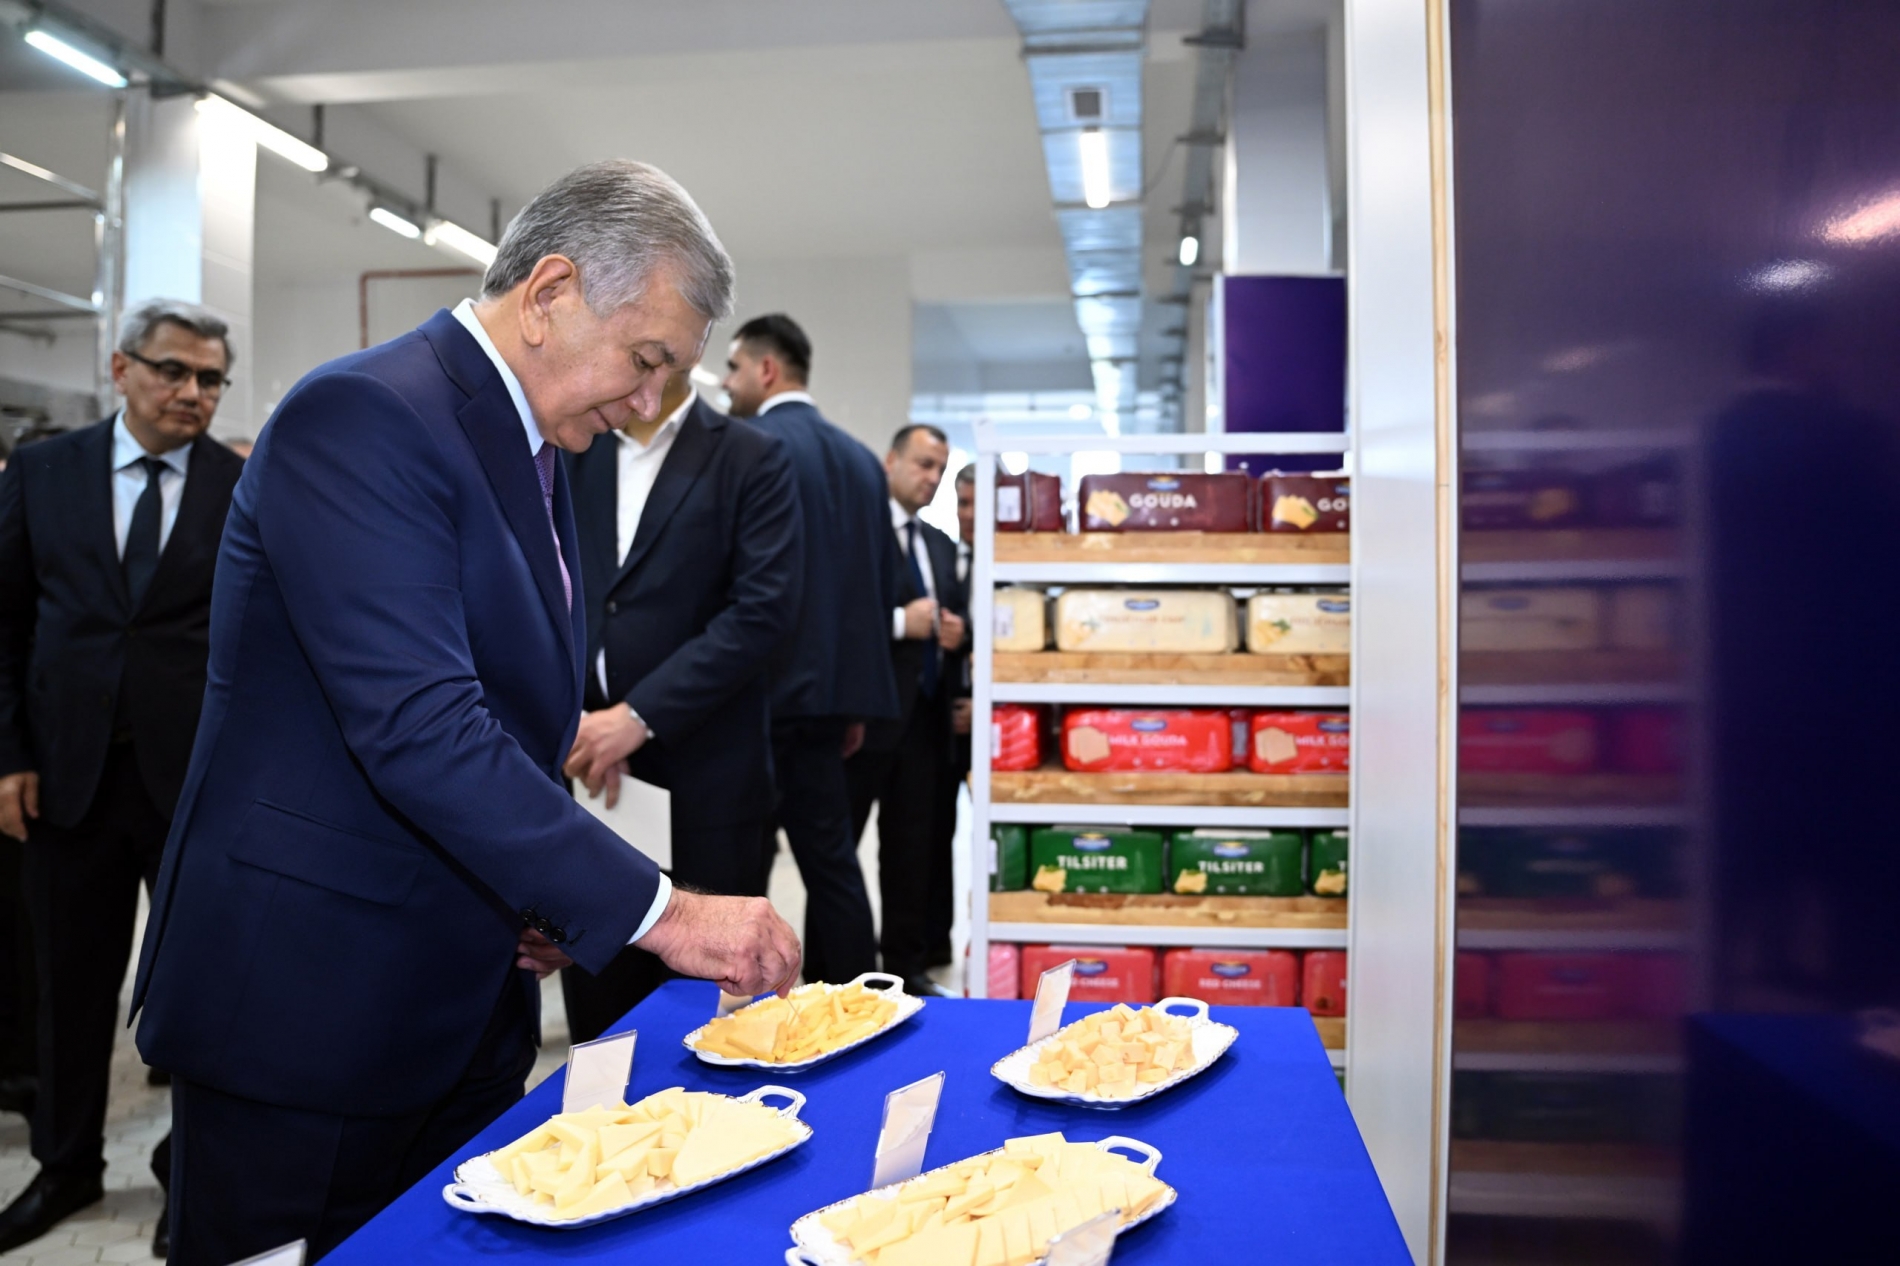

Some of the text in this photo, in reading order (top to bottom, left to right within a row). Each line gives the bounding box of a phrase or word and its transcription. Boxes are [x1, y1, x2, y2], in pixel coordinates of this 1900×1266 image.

[1128, 492, 1198, 509] GOUDA
[1141, 734, 1188, 747] GOUDA
[1056, 855, 1129, 870] TILSITER
[1197, 860, 1265, 874] TILSITER
[1198, 978, 1220, 989] RED
